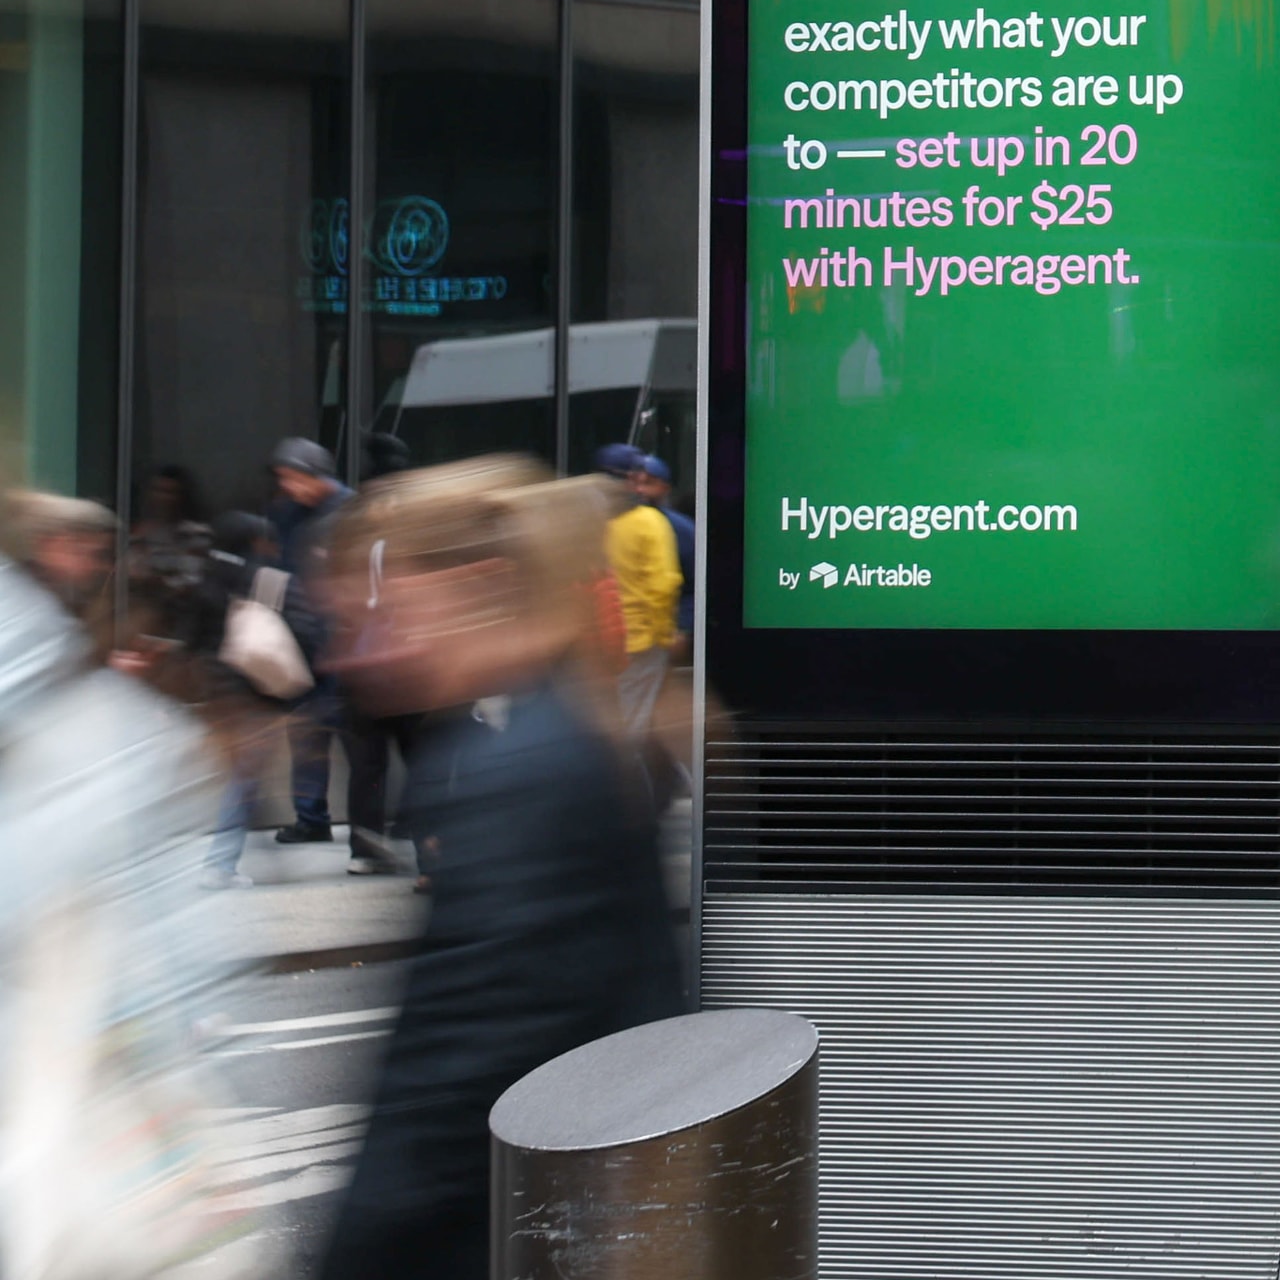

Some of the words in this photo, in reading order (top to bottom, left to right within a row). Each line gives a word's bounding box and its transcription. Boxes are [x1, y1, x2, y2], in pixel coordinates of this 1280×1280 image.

[784, 9, 933, 61] exactly
[938, 8, 1044, 50] what
[1050, 15, 1147, 58] your
[784, 68, 1043, 120] competitors
[1051, 75, 1119, 107] are
[1128, 74, 1184, 115] up
[783, 134, 828, 170] to
[895, 131, 962, 169] set
[969, 136, 1025, 177] up
[1034, 125, 1071, 166] in
[1080, 124, 1138, 166] 20
[784, 188, 954, 229] minutes
[961, 185, 1024, 227] for
[1030, 179, 1113, 231] $25
[783, 247, 873, 288] with
[883, 246, 1140, 296] Hyperagent.
[781, 497, 1078, 540] Hyperagent.com
[779, 568, 801, 590] by
[843, 563, 932, 588] Airtable
